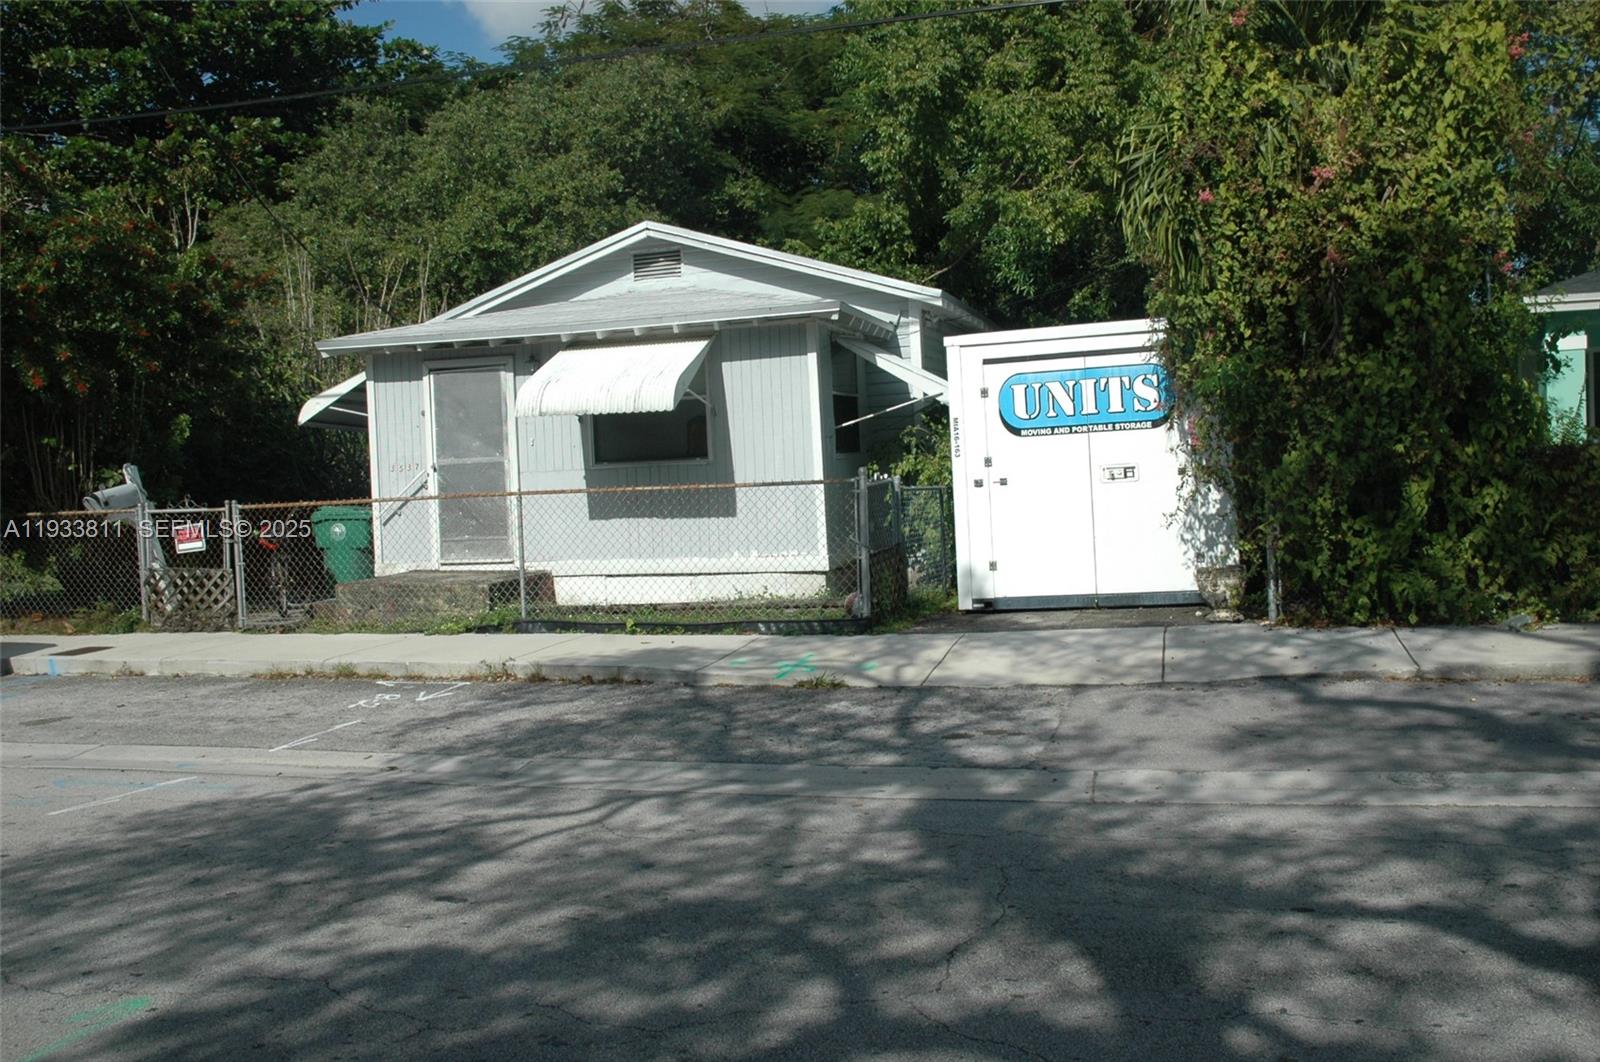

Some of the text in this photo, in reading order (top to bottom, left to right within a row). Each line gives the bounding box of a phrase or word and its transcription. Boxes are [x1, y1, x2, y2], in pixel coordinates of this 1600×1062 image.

[1010, 374, 1160, 420] UNITS
[1020, 420, 1153, 437] MOVING AND PORTABLE STORAGE
